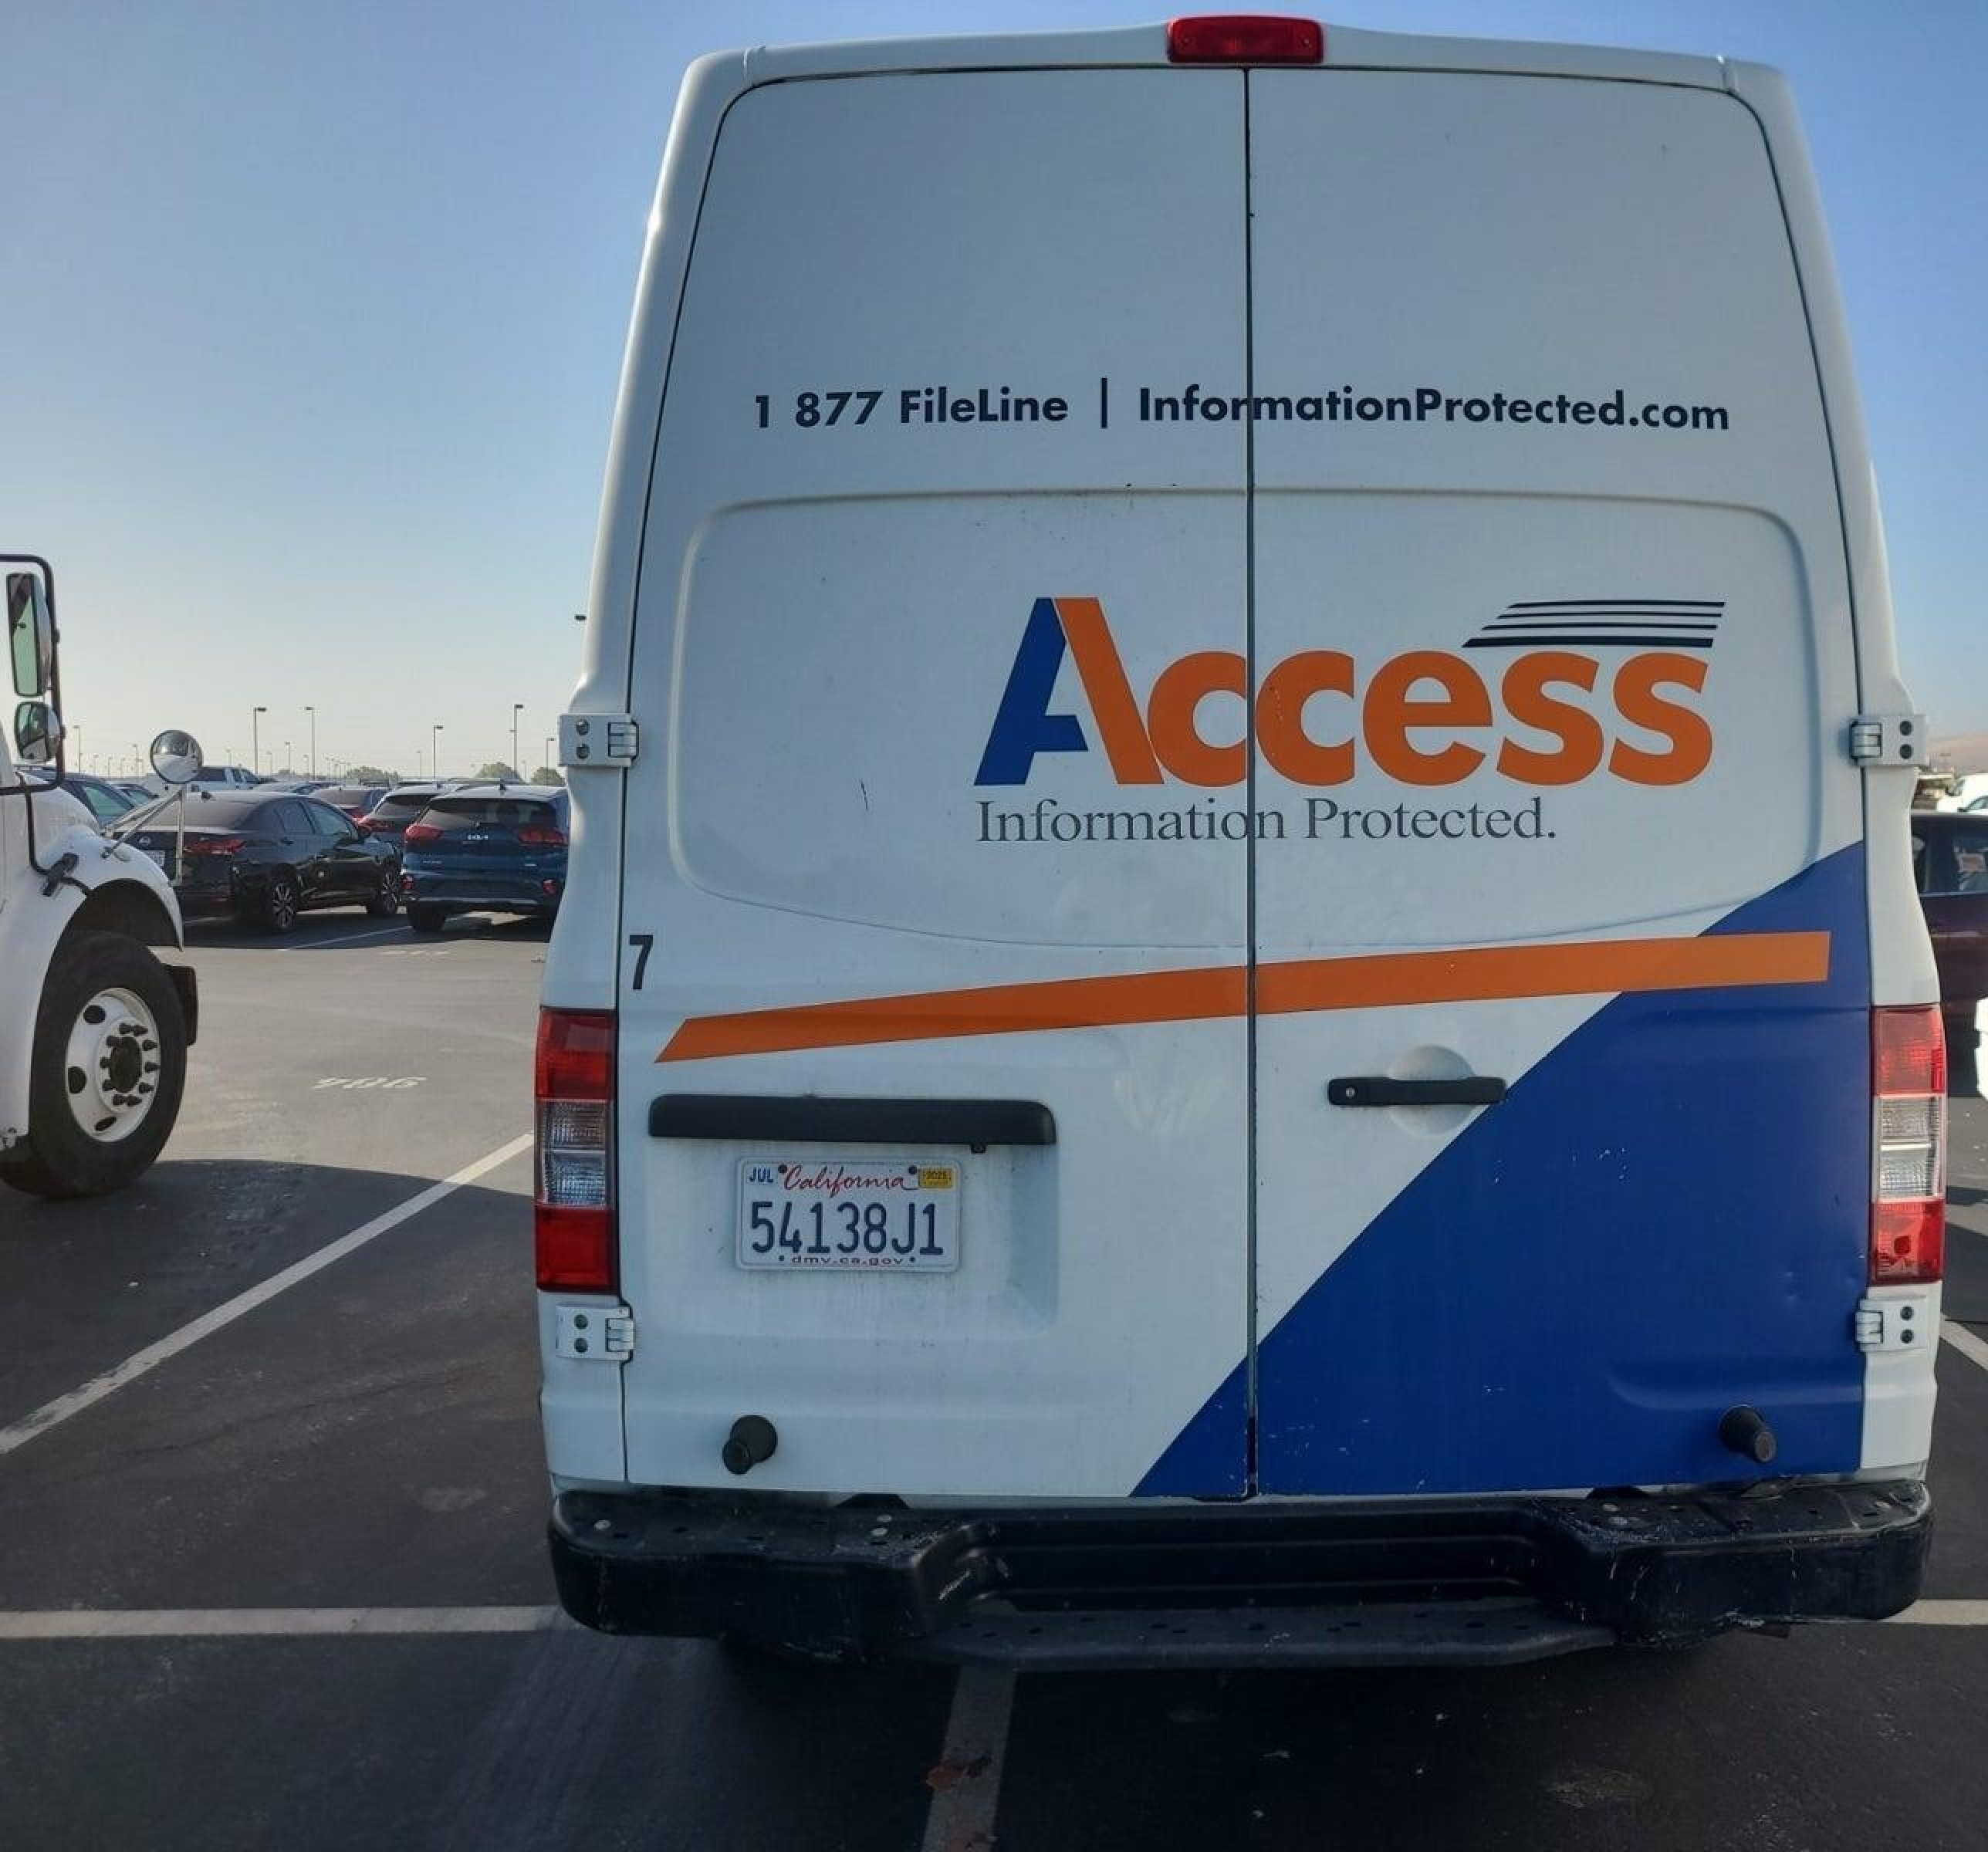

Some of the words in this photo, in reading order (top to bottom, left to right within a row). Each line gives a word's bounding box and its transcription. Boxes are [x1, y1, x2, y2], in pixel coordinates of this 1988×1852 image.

[755, 394, 769, 428] 1
[794, 392, 883, 428] 877
[900, 387, 1068, 424] FileLine
[1140, 384, 1729, 429] InformationProtected.com
[973, 596, 1713, 787] Access
[976, 798, 1285, 842] Information
[1305, 796, 1556, 841] Protected.
[629, 934, 654, 989] 7
[749, 1168, 773, 1183] JUL
[783, 1165, 905, 1198] California
[752, 1201, 943, 1255] 54138J1
[791, 1255, 904, 1266] dmv.ca.gov
